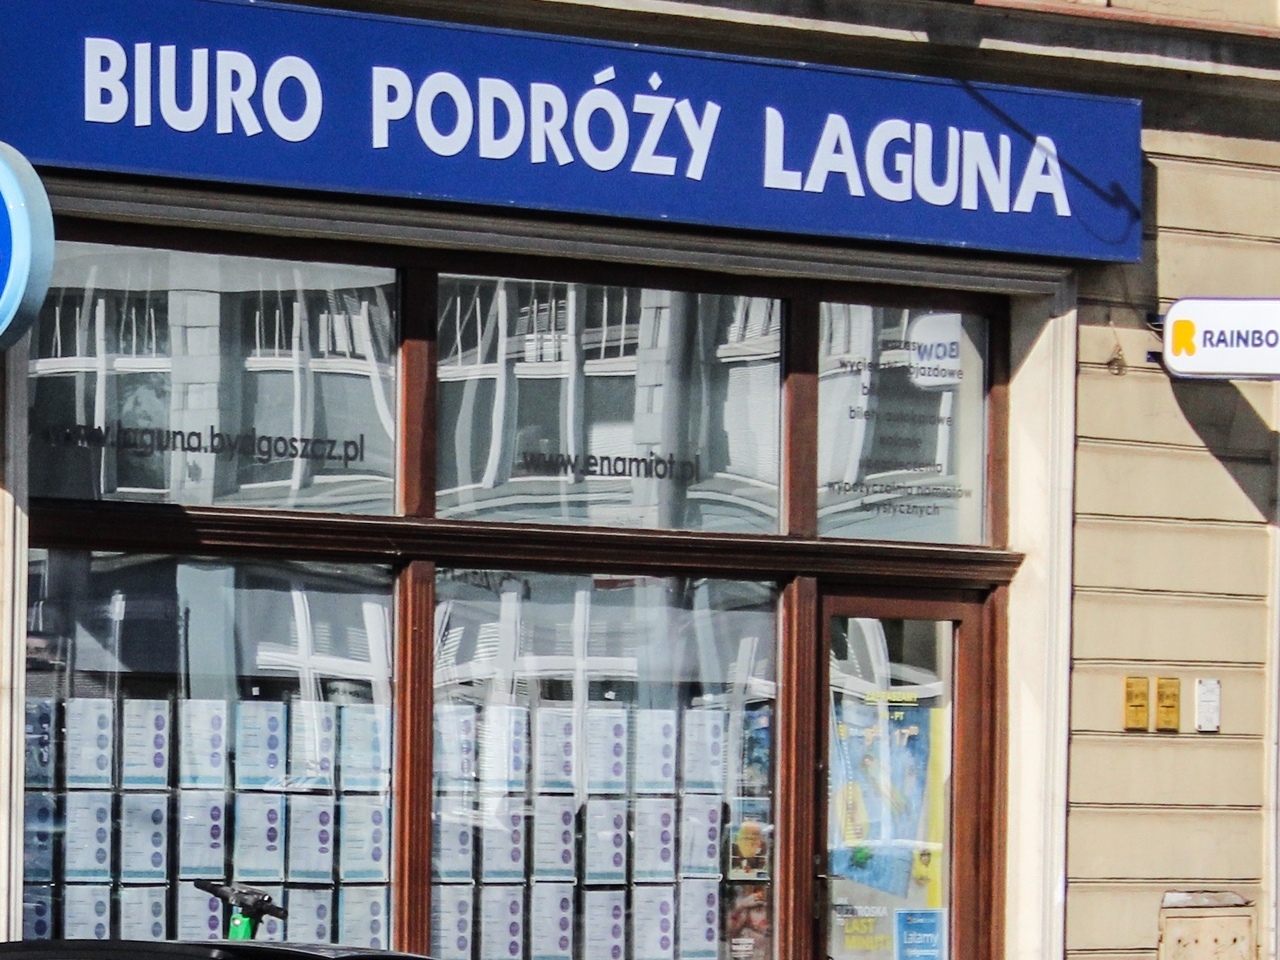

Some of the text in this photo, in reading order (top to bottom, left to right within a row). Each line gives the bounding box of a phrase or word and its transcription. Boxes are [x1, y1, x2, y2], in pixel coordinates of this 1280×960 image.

[83, 37, 1072, 217] BIURO PODRÓŻY LAGUNA
